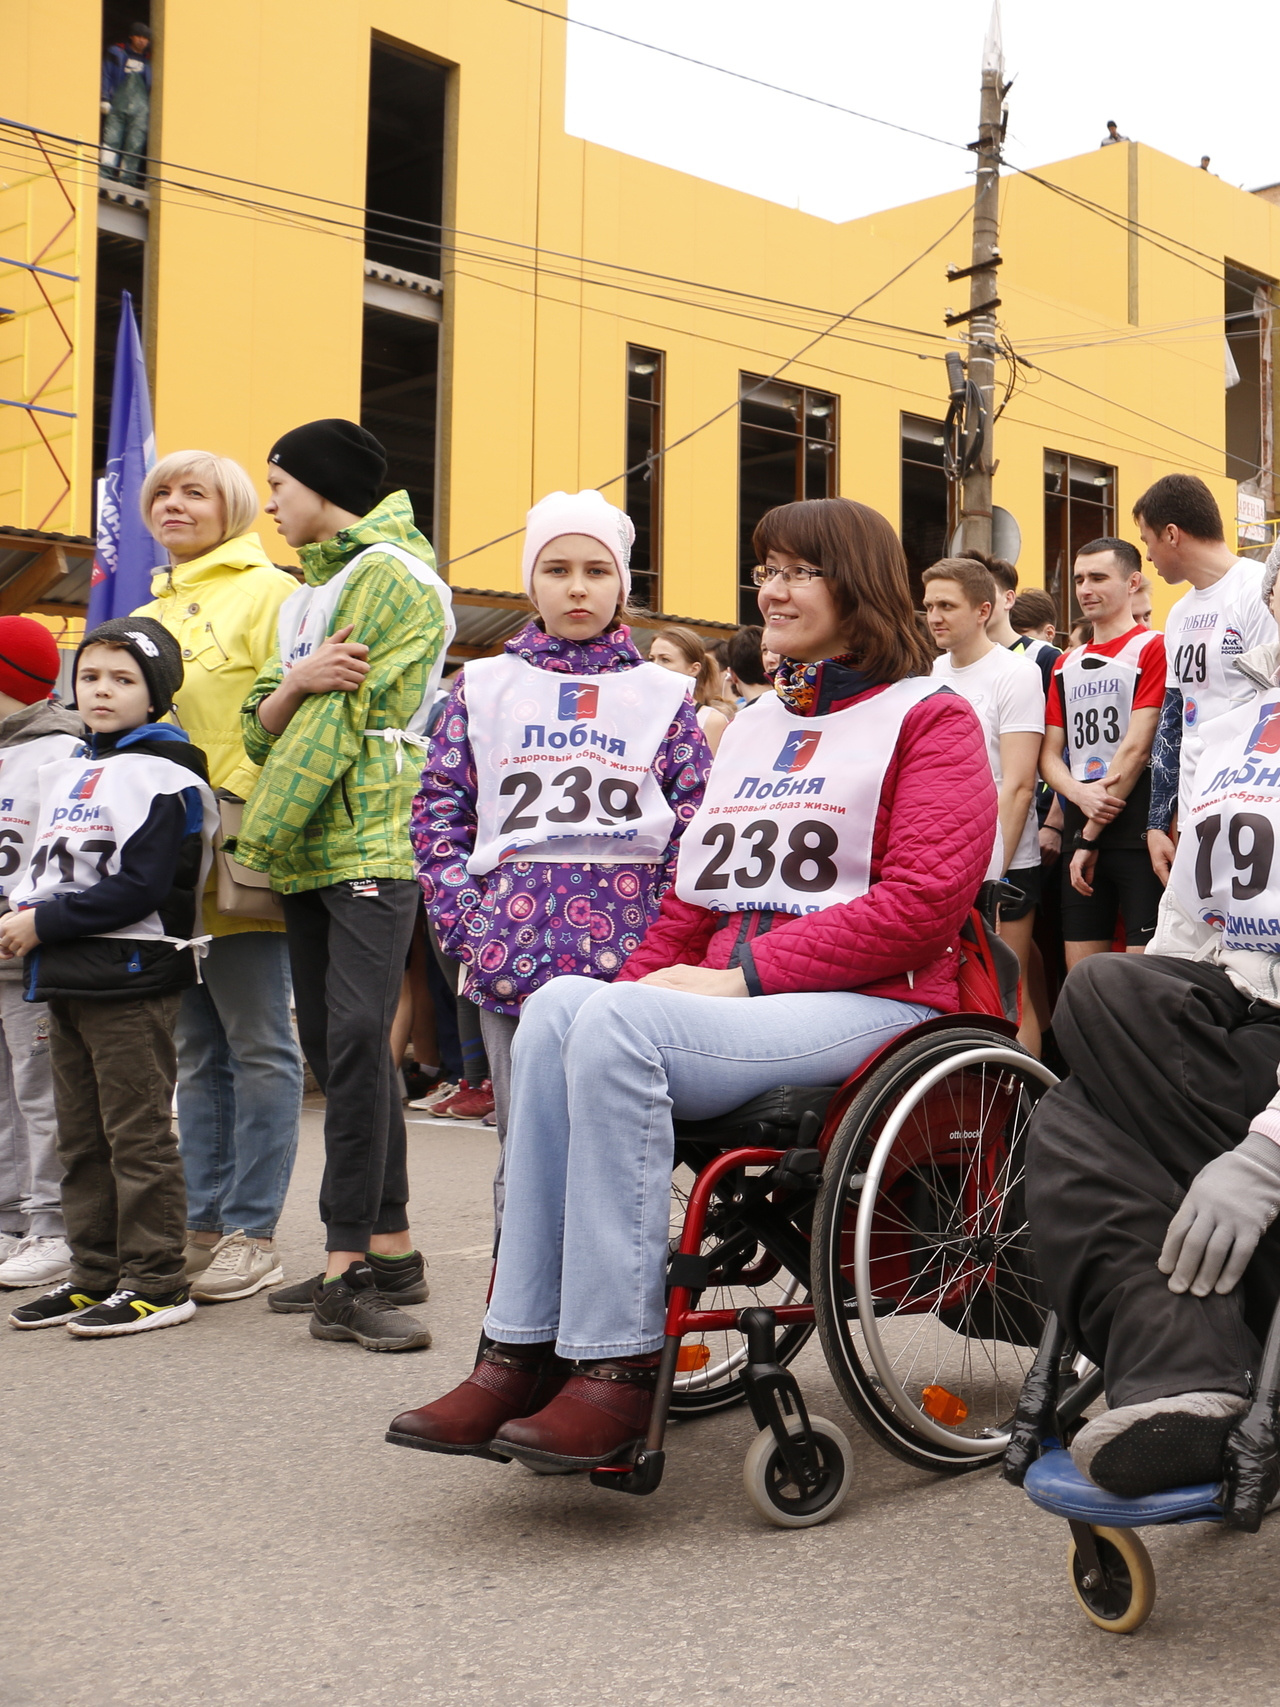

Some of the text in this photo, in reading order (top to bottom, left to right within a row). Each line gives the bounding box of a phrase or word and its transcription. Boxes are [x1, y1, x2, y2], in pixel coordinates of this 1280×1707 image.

[1174, 642, 1207, 684] 429
[1070, 678, 1120, 702] ЛОБНЯ
[521, 723, 627, 757] Лобня
[1074, 705, 1120, 750] 383
[512, 752, 572, 765] здоровый
[576, 749, 607, 765] образ
[610, 761, 650, 774] жизни
[733, 776, 826, 799] Лобня
[708, 800, 847, 815] за здоровый образ жизни
[694, 819, 839, 893] 238
[1195, 813, 1275, 900] 19
